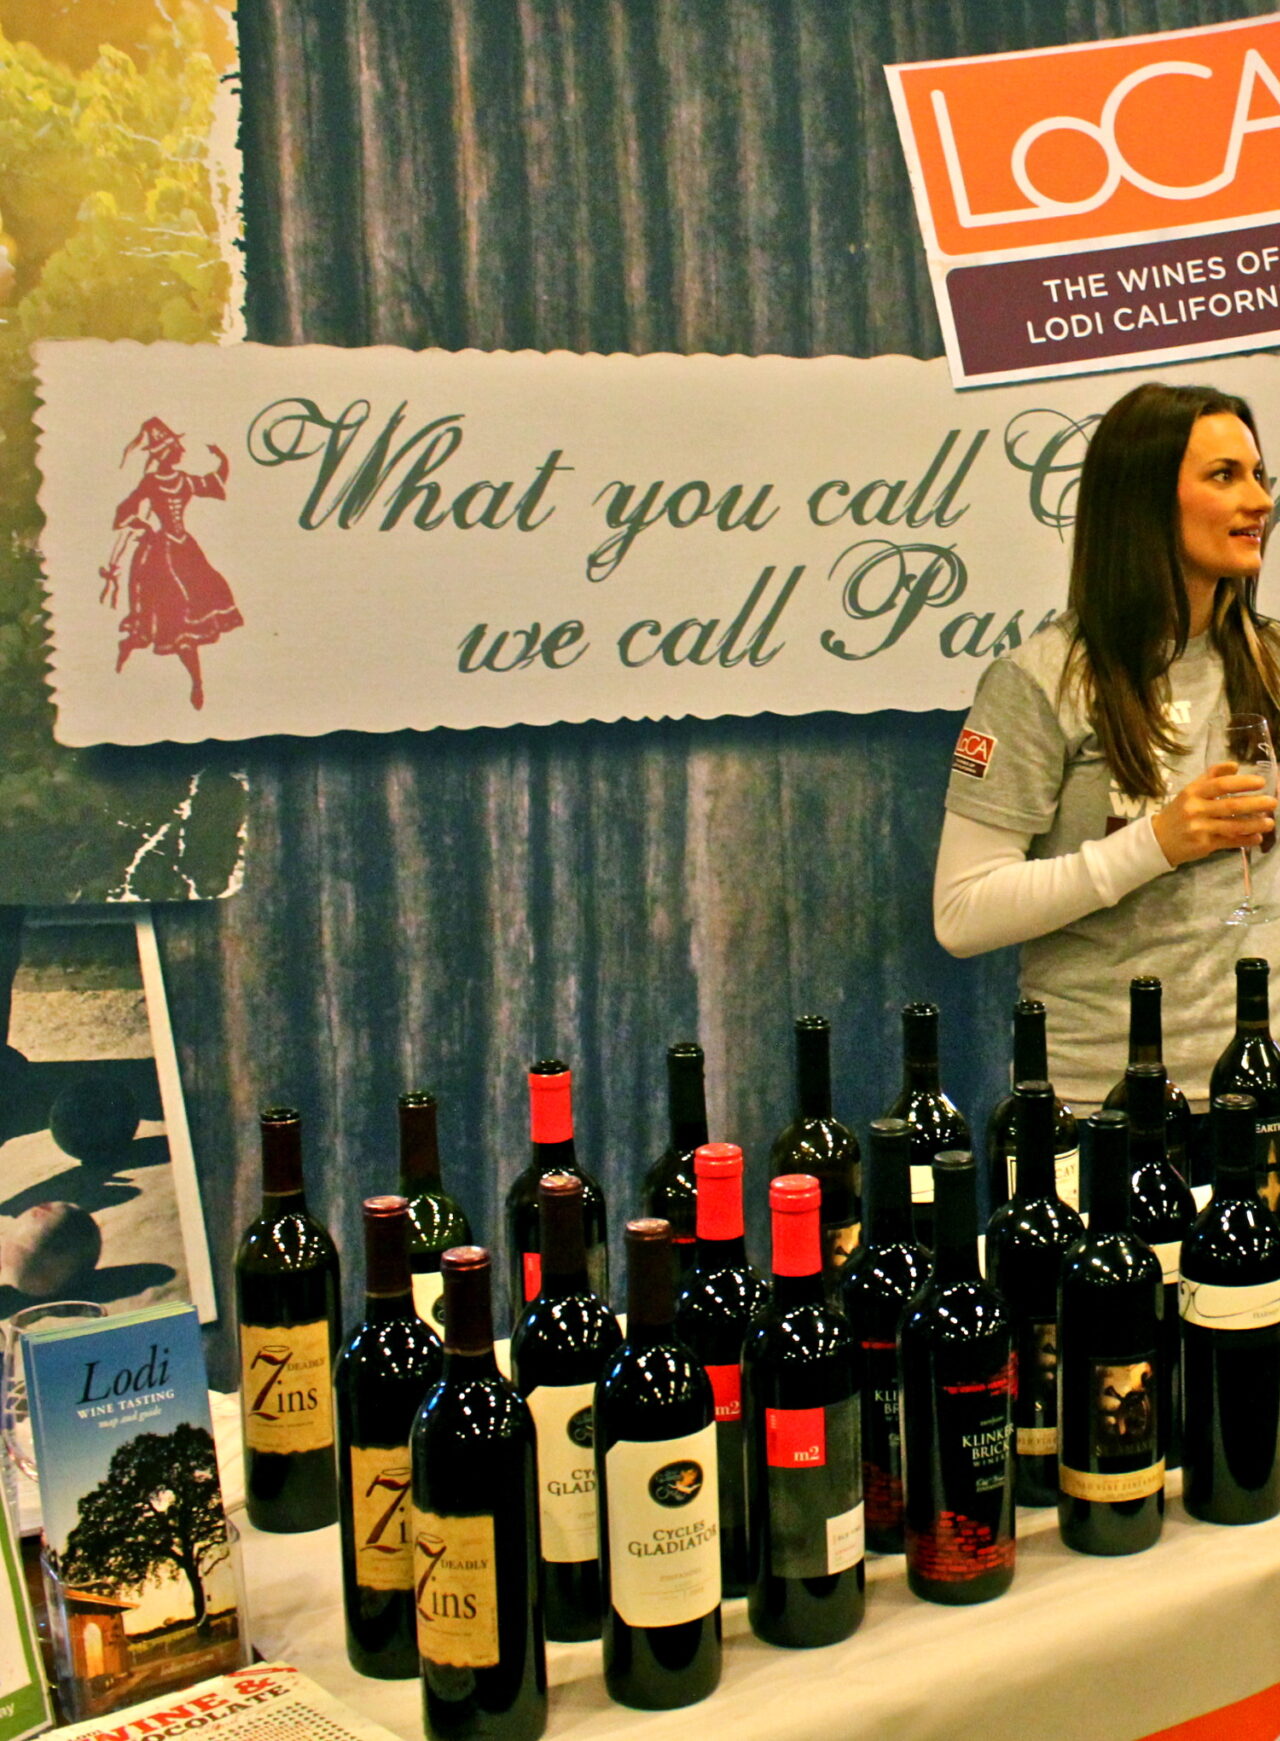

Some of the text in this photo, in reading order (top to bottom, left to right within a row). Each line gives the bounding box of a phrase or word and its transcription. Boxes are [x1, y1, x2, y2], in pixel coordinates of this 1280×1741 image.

[1043, 247, 1280, 303] THE WINES OF
[1026, 310, 1104, 344] LODI
[246, 397, 574, 532] What
[586, 478, 781, 583] you
[808, 428, 990, 529] call
[456, 619, 590, 674] we
[616, 565, 806, 669] call
[75, 1344, 170, 1405] Lodi
[77, 1388, 175, 1419] WINE TASTING
[794, 1445, 820, 1462] m2
[628, 1523, 717, 1558] GLADIATOR
[652, 1520, 705, 1541] CYCLES
[141, 1685, 291, 1741] OCOLATE
